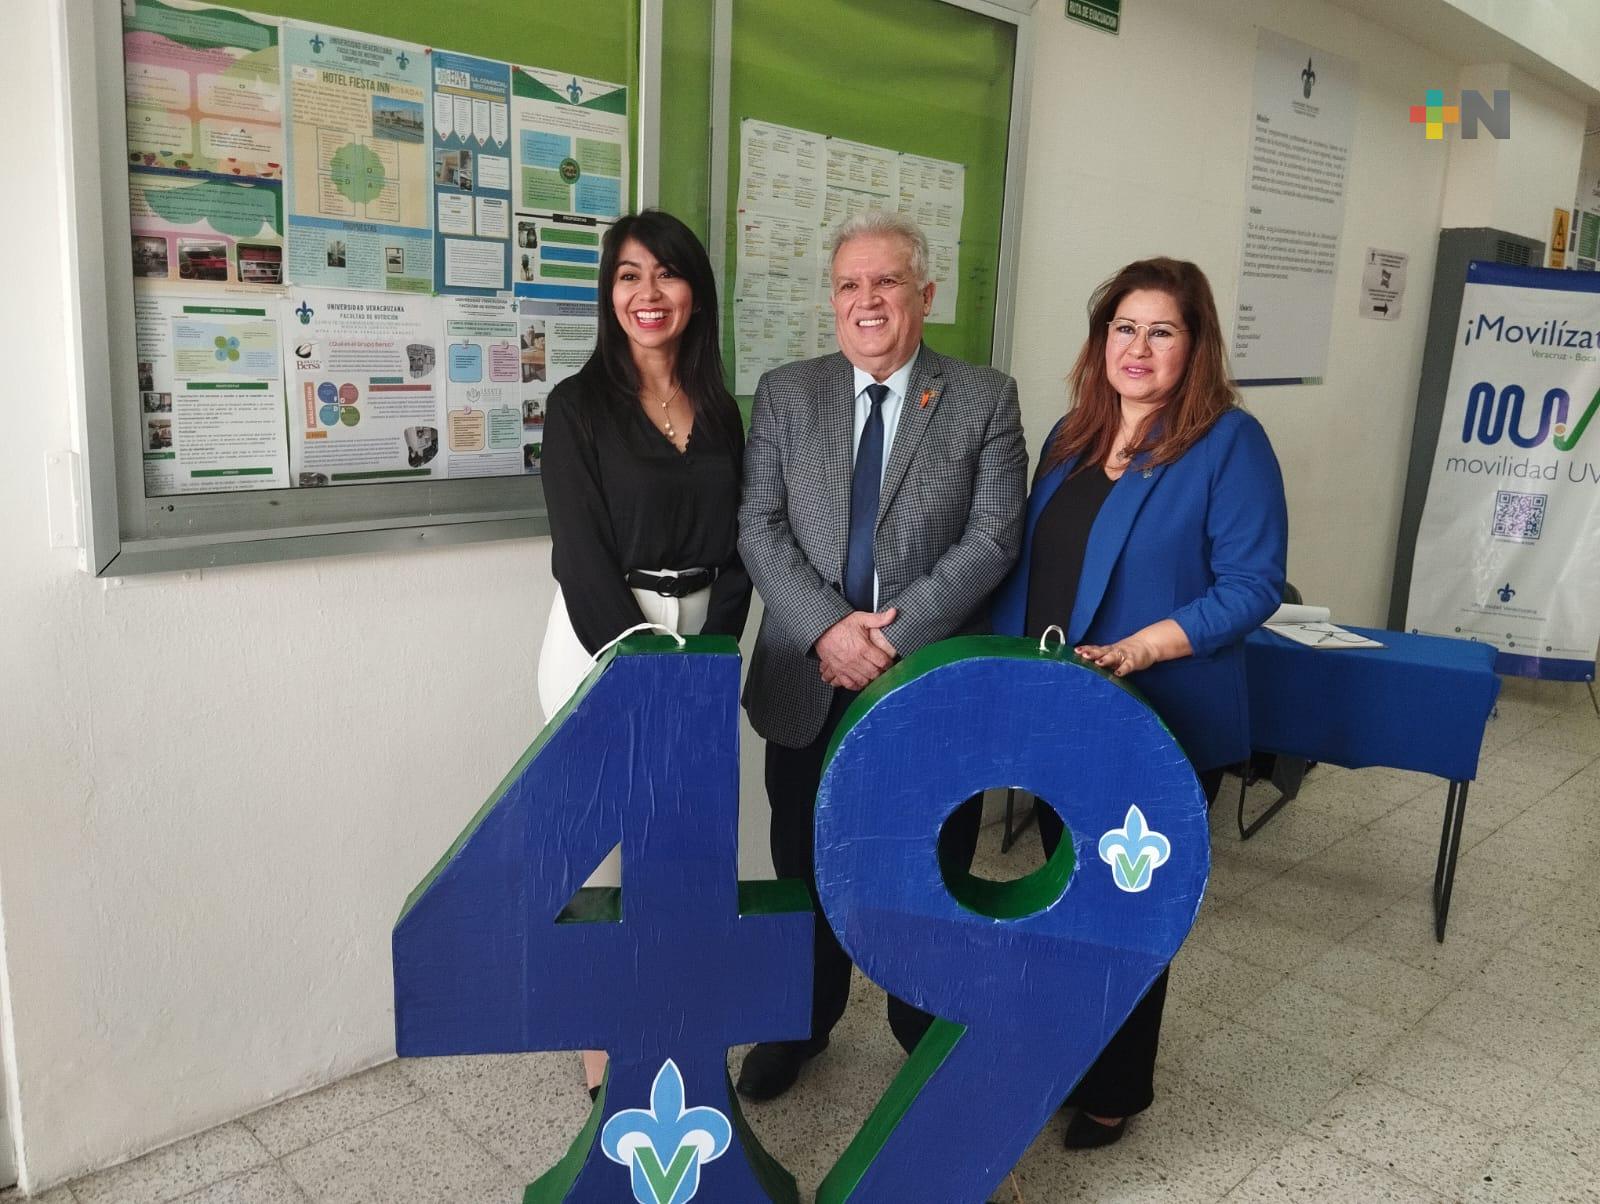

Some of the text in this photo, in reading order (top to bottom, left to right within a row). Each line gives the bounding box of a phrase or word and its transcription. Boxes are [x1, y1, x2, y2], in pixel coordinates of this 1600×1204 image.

[322, 71, 347, 87] HOTEL
[349, 76, 375, 91] FIESTA
[376, 81, 390, 93] INN
[327, 303, 405, 312] UNIVERSIDAD VERACRUZANA
[1446, 456, 1559, 481] movilidad
